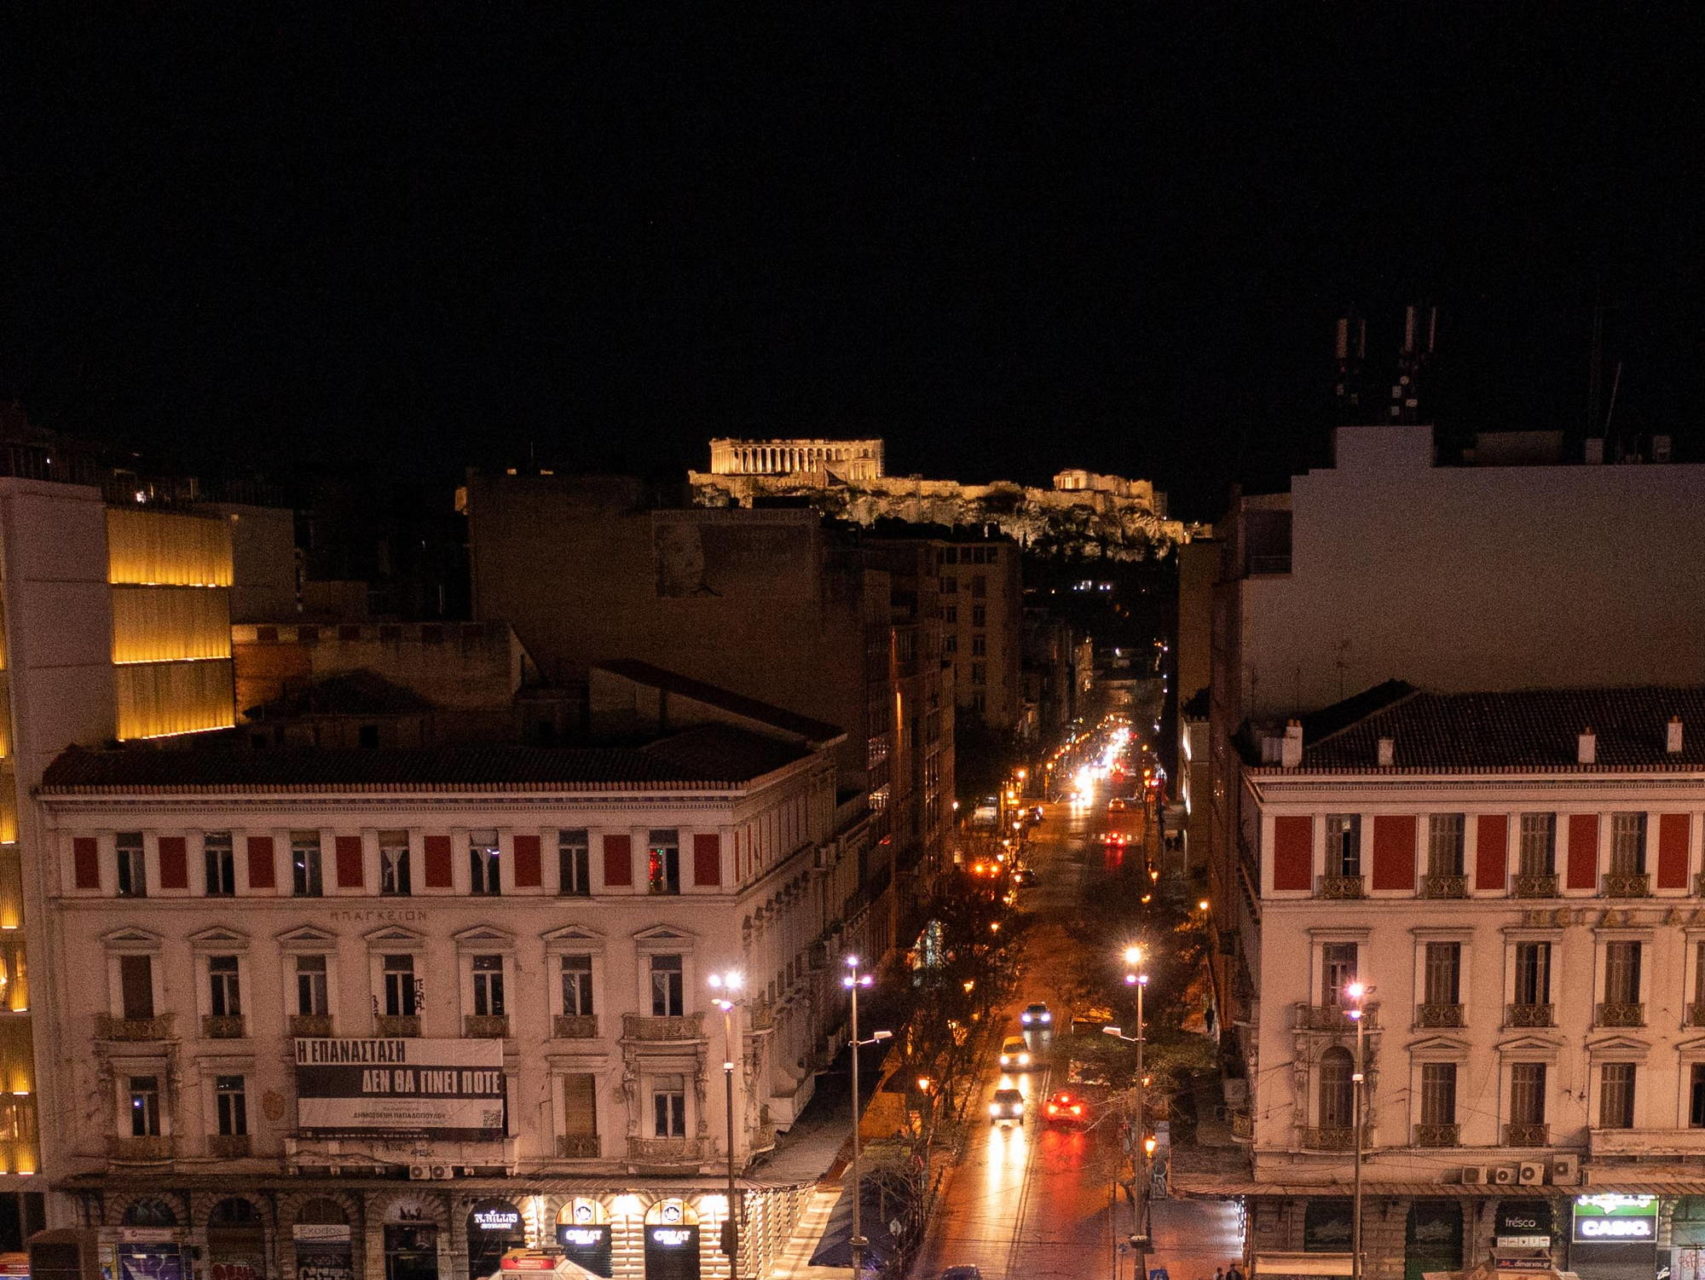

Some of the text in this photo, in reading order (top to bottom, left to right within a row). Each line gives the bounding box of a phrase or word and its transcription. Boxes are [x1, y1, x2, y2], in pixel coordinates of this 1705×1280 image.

[297, 1040, 406, 1063] Η ΕΠΑΝΑΣΤΑΣΗ
[362, 1069, 500, 1094] ΔΕΝ ΘΑ ΓΙΝΕΙ ΠΟΤΕ
